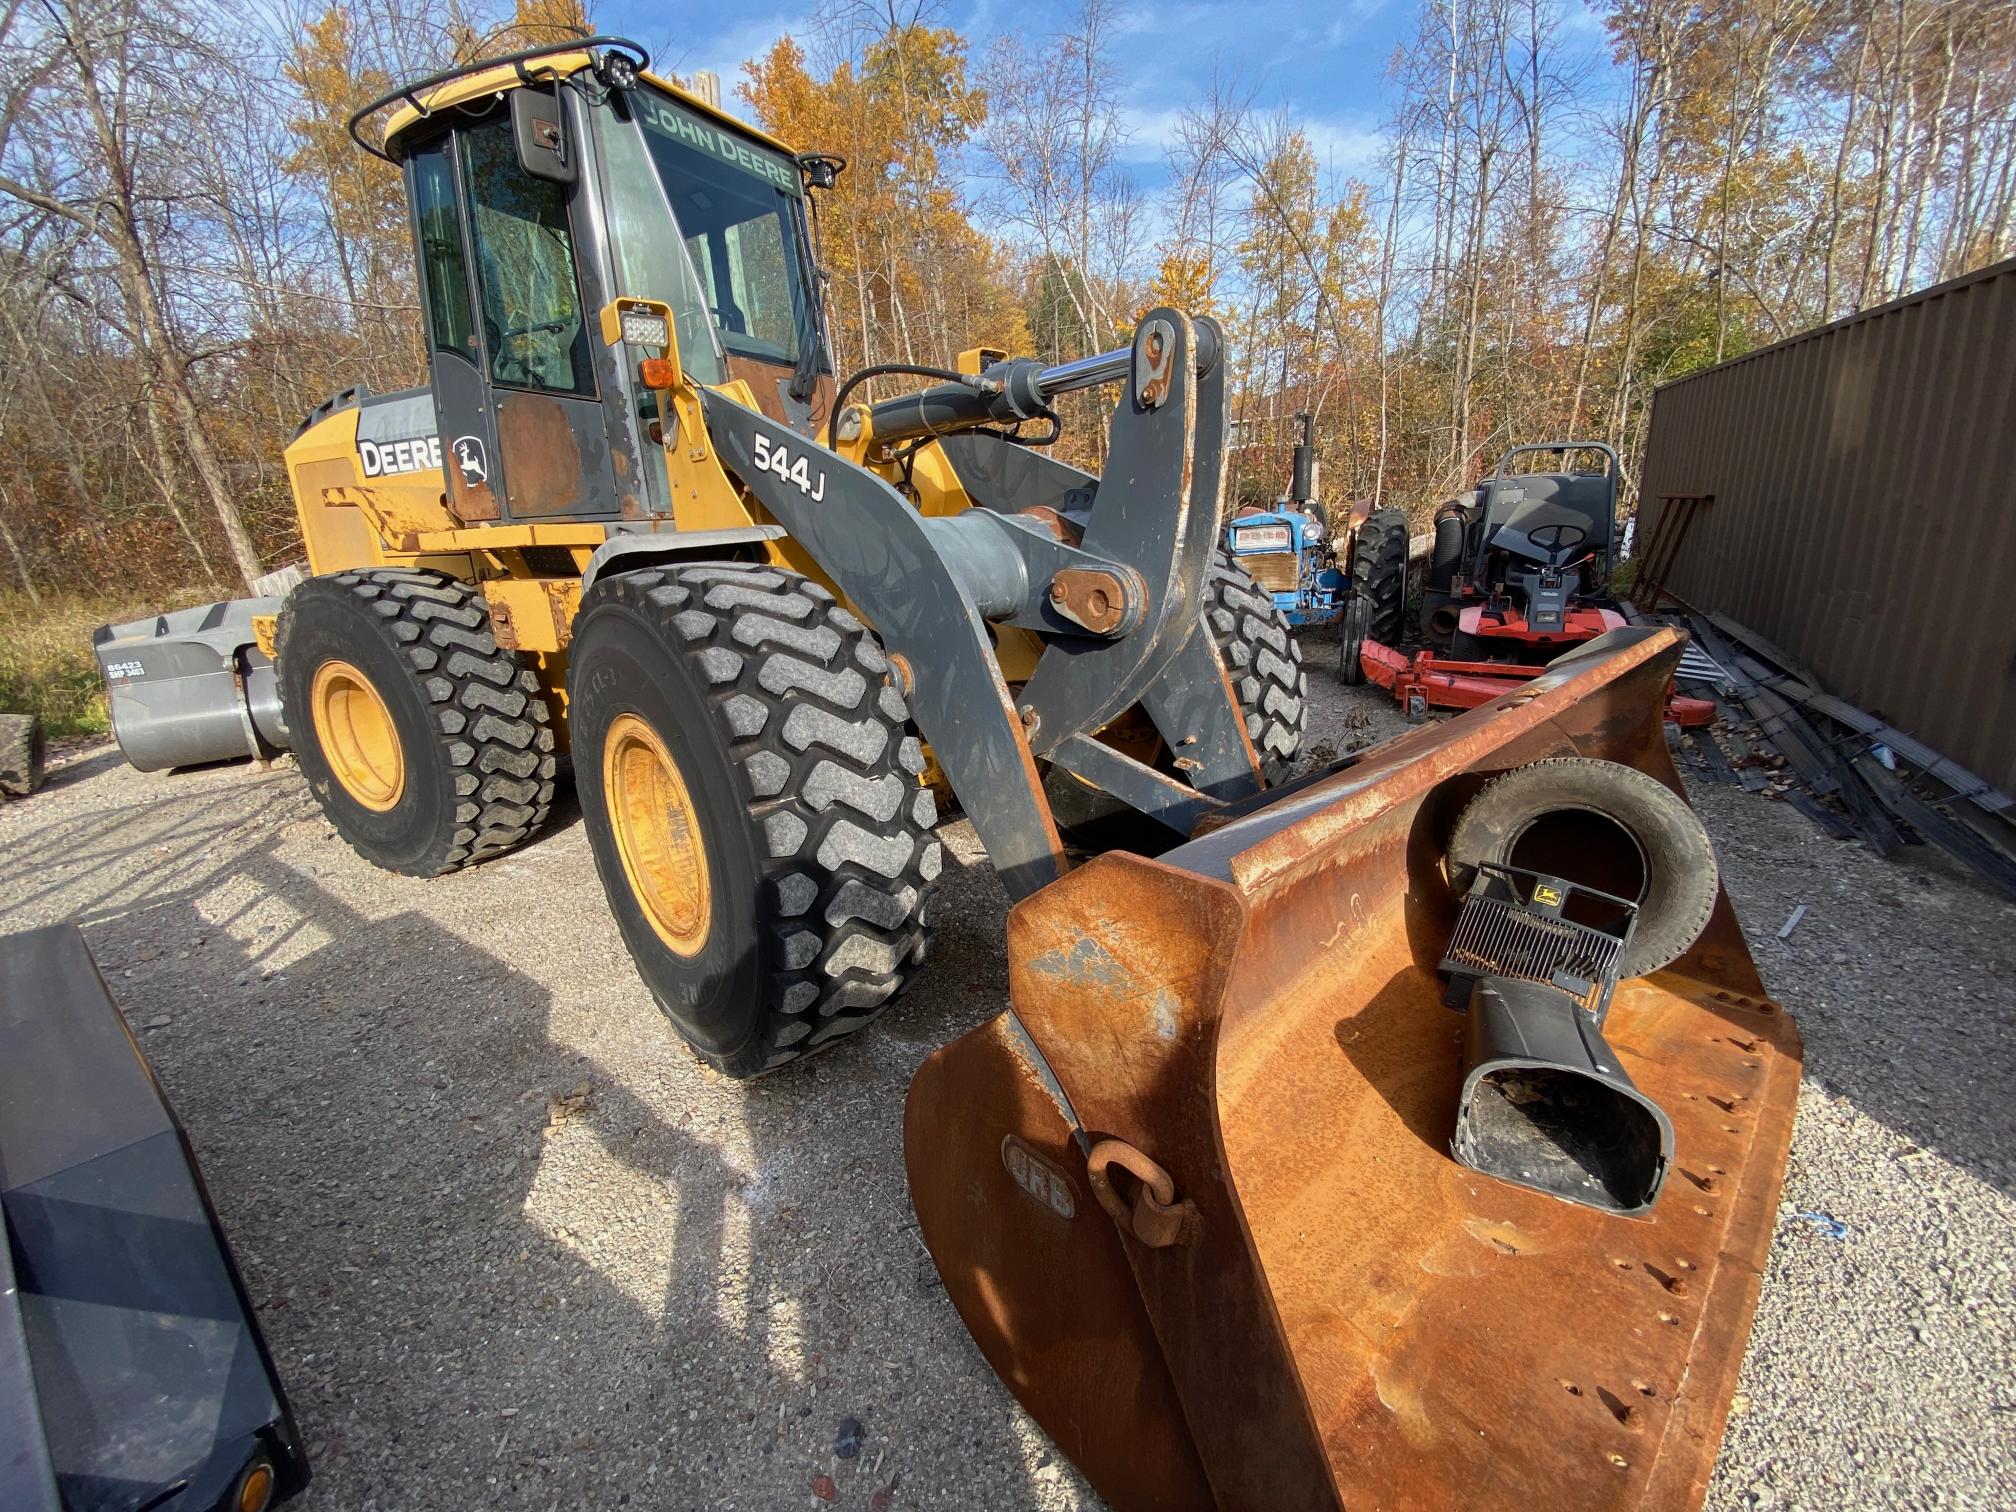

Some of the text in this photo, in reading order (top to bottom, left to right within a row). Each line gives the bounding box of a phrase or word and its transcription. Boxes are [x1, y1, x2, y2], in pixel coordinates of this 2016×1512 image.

[645, 99, 794, 189] JOHN DEERE
[359, 437, 443, 476] DEERE
[754, 432, 826, 502] 544J
